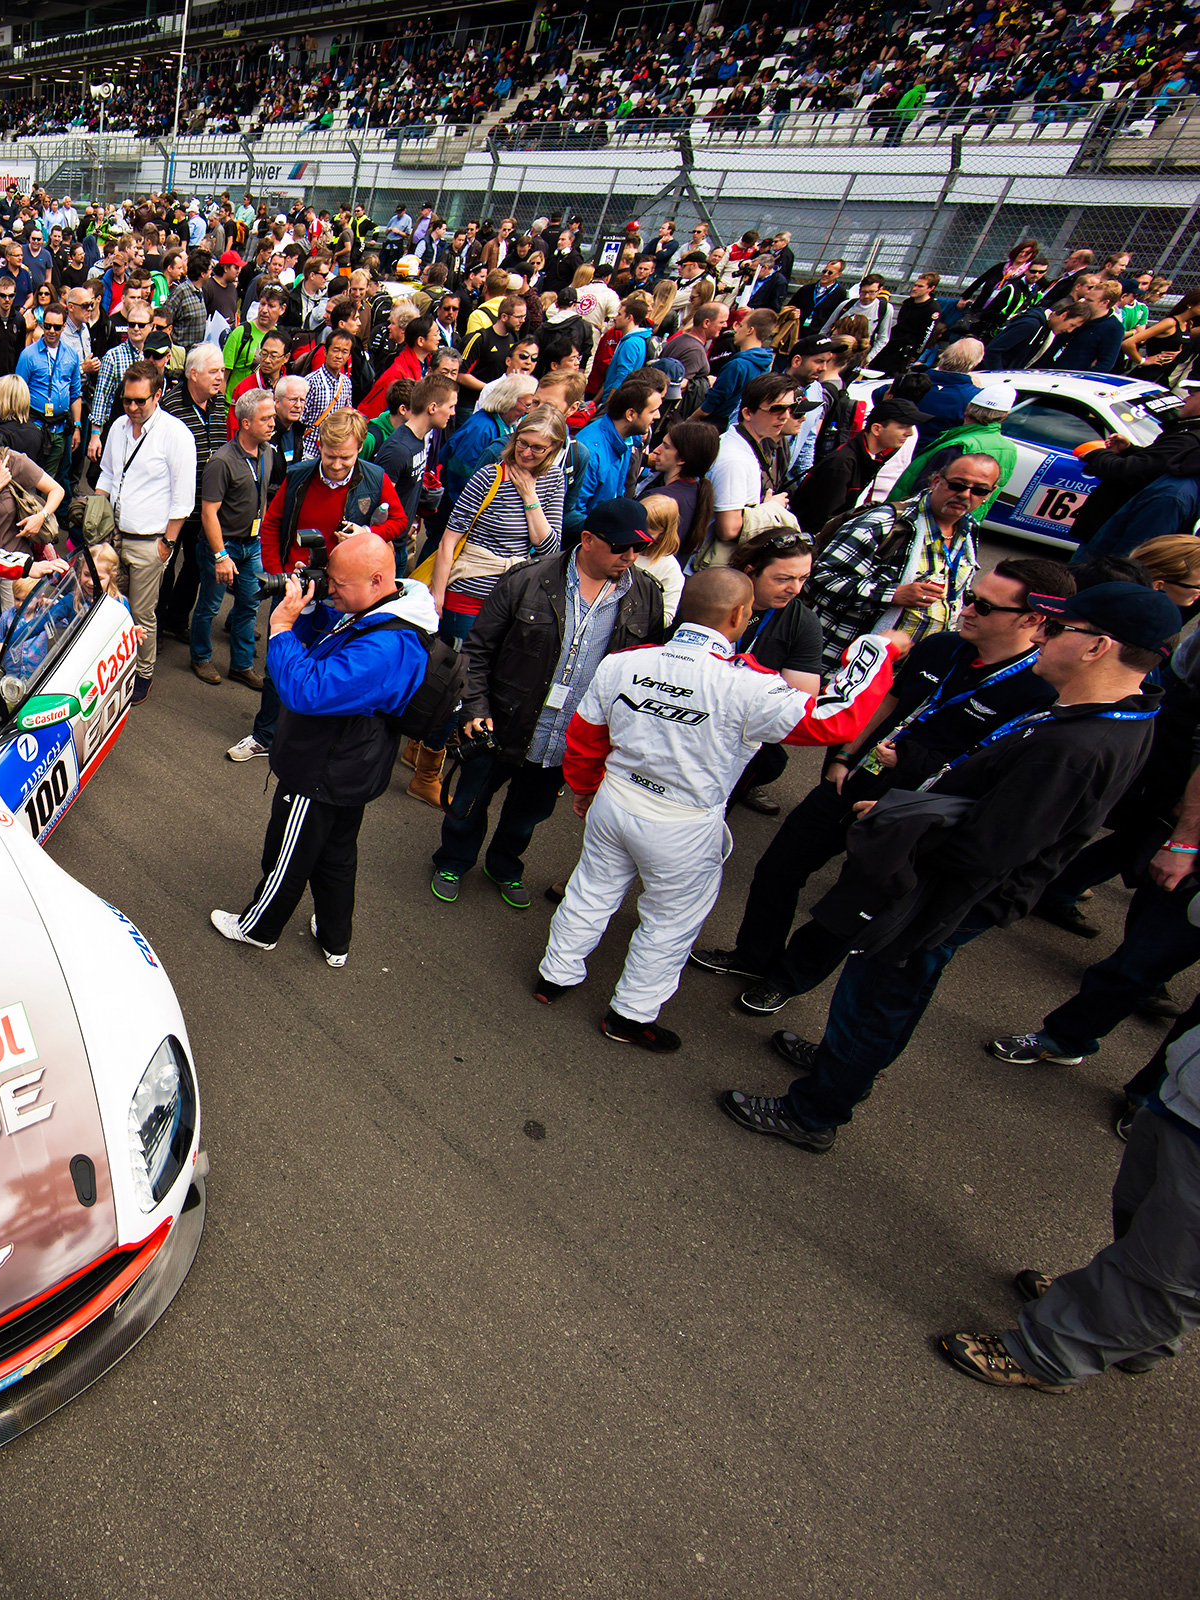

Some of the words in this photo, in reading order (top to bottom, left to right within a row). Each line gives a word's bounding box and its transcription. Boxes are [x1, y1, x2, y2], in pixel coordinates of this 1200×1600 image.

[189, 162, 222, 179] BMW
[224, 162, 236, 180] M
[1038, 454, 1056, 475] ADAC
[1054, 478, 1098, 494] ZURIC
[96, 625, 137, 696] Castr
[632, 674, 694, 698] Vantage
[34, 708, 66, 726] Castrol
[20, 741, 62, 794] ZURICH
[630, 772, 666, 794] sparco
[24, 759, 68, 840] 100
